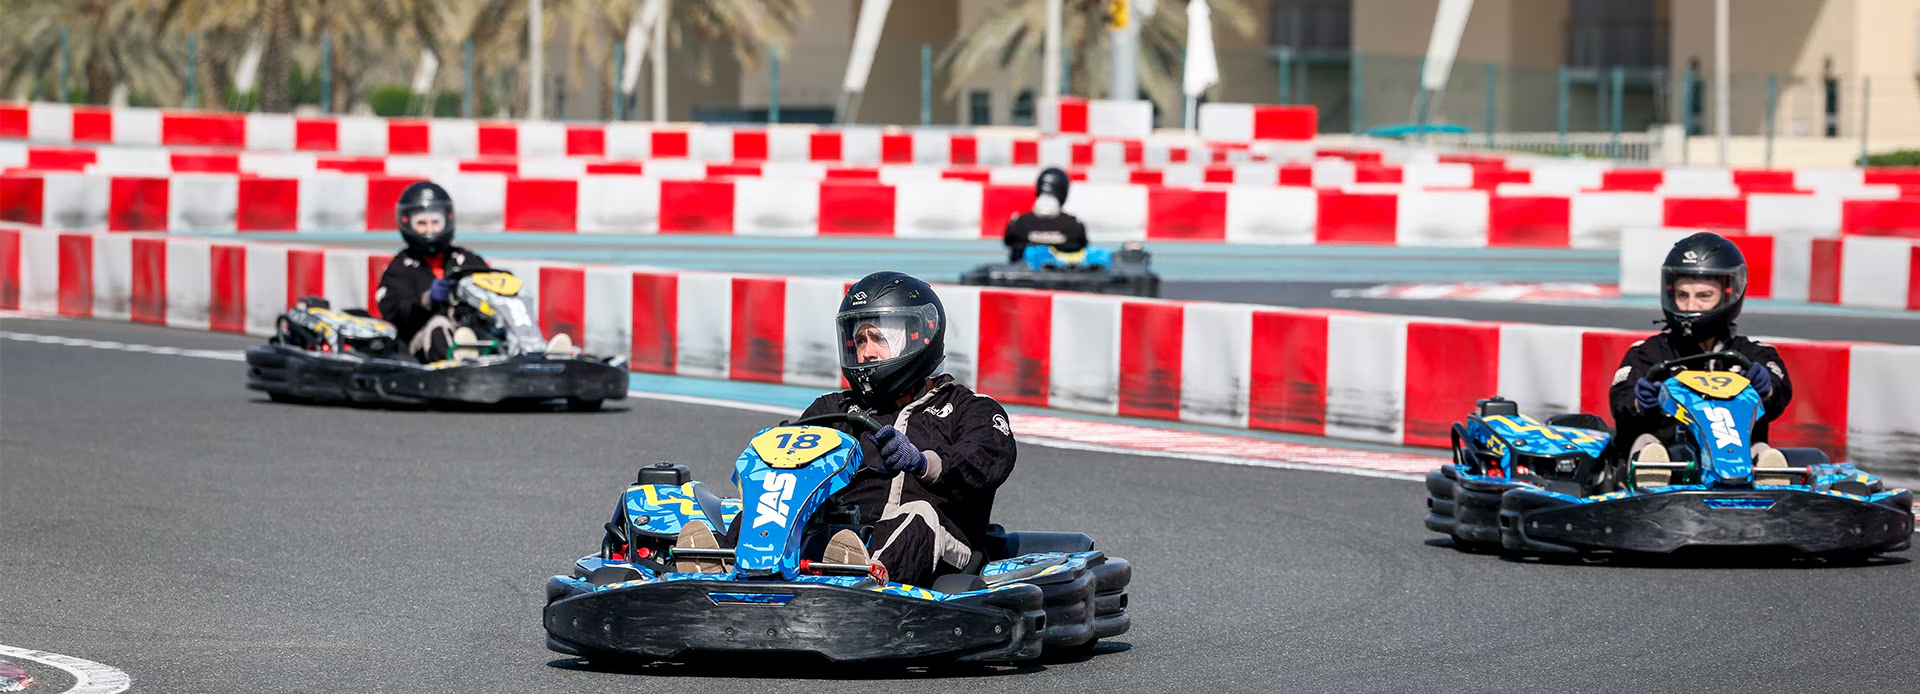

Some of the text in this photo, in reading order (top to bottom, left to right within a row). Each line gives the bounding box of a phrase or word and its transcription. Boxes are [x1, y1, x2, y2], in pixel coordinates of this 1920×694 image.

[1693, 376, 1732, 387] 19
[776, 433, 821, 450] 18
[1703, 407, 1742, 449] YAS
[753, 473, 797, 528] YAS
